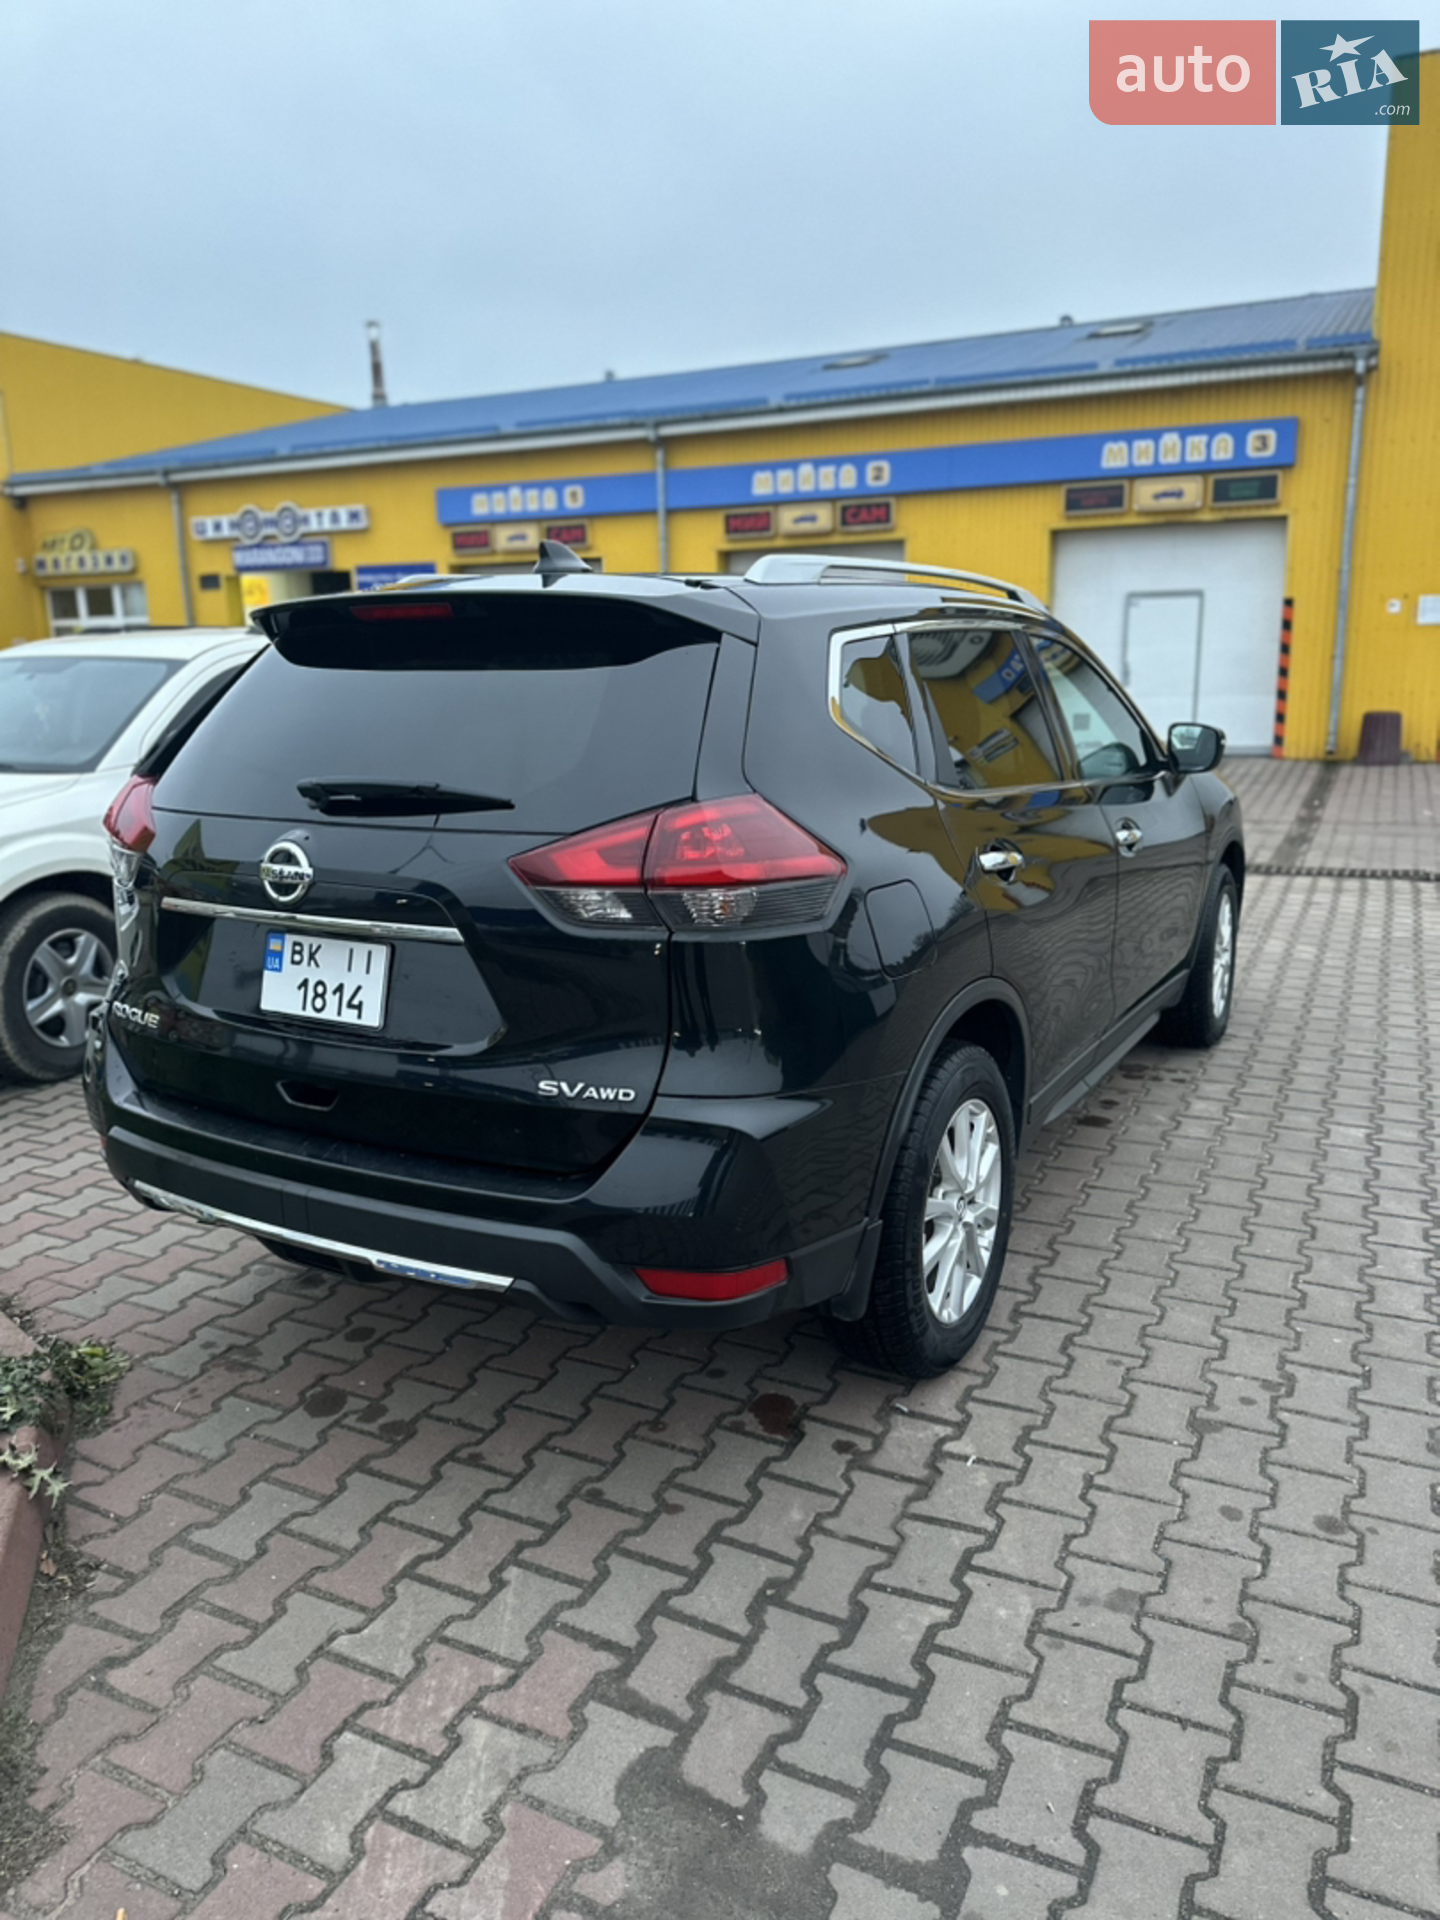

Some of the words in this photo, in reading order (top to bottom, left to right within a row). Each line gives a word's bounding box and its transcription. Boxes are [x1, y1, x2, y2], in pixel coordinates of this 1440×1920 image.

[1101, 432, 1235, 468] МИЙКА
[751, 462, 857, 495] МИЙКА
[845, 505, 887, 526] САМ
[266, 955, 281, 970] UA
[290, 940, 322, 968] BK
[296, 977, 364, 1020] 1814
[537, 1080, 586, 1098] SV
[581, 1086, 636, 1102] AWD
